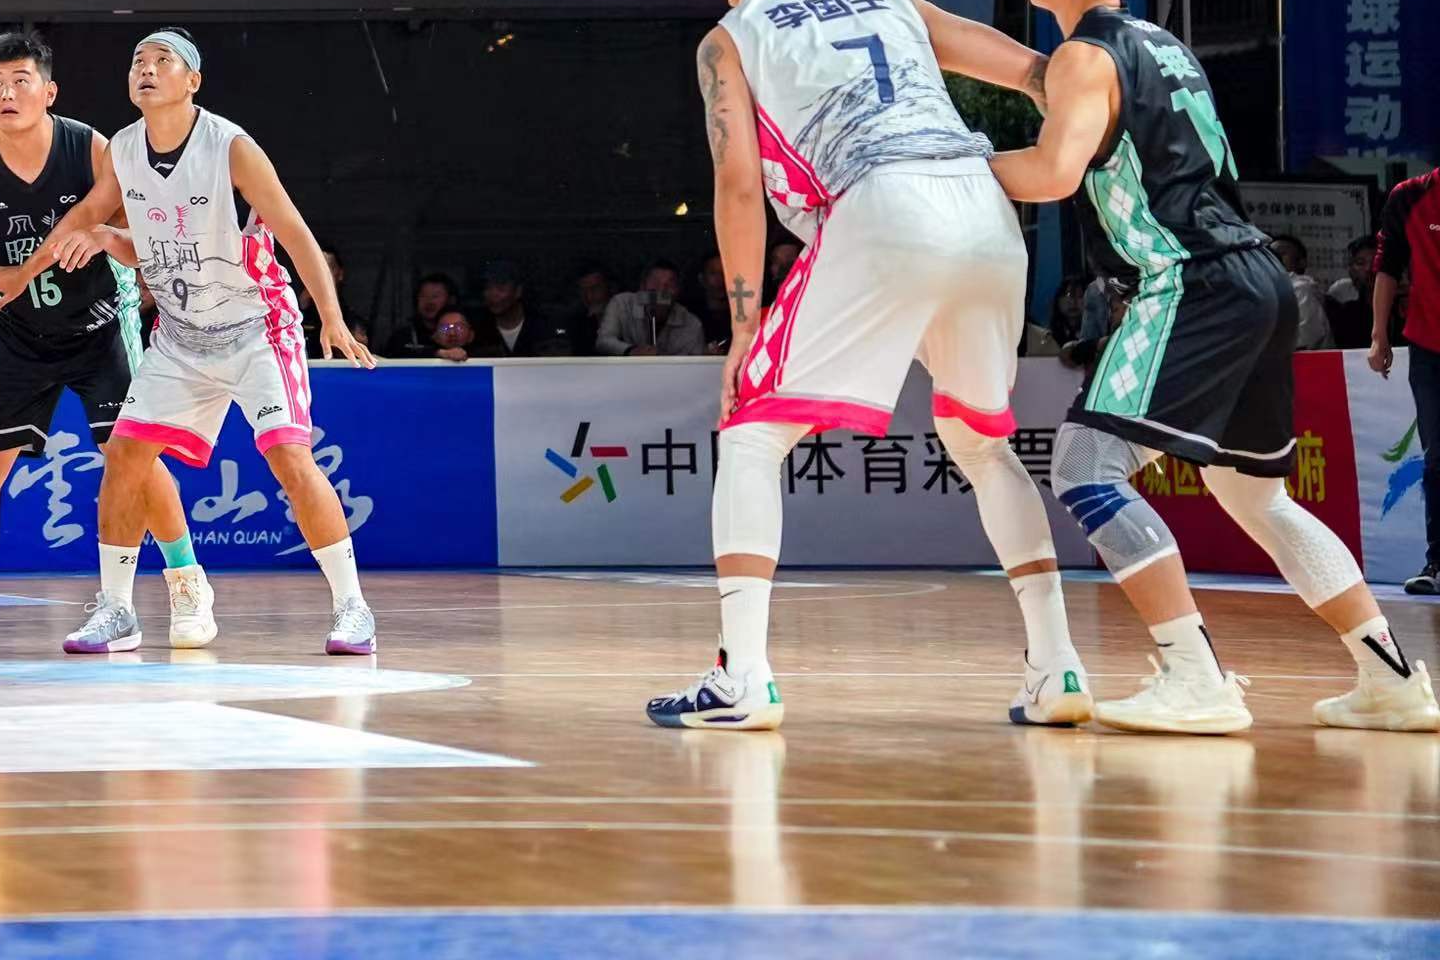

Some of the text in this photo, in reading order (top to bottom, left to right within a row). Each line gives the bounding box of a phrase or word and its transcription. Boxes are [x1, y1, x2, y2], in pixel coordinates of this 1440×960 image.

[831, 33, 895, 104] 7
[5, 236, 44, 266] 昭
[147, 236, 201, 272] 红河
[28, 270, 63, 309] 15
[172, 277, 188, 312] 9
[641, 426, 1056, 496] 中体育彩票
[192, 530, 282, 545] HAN QUAN
